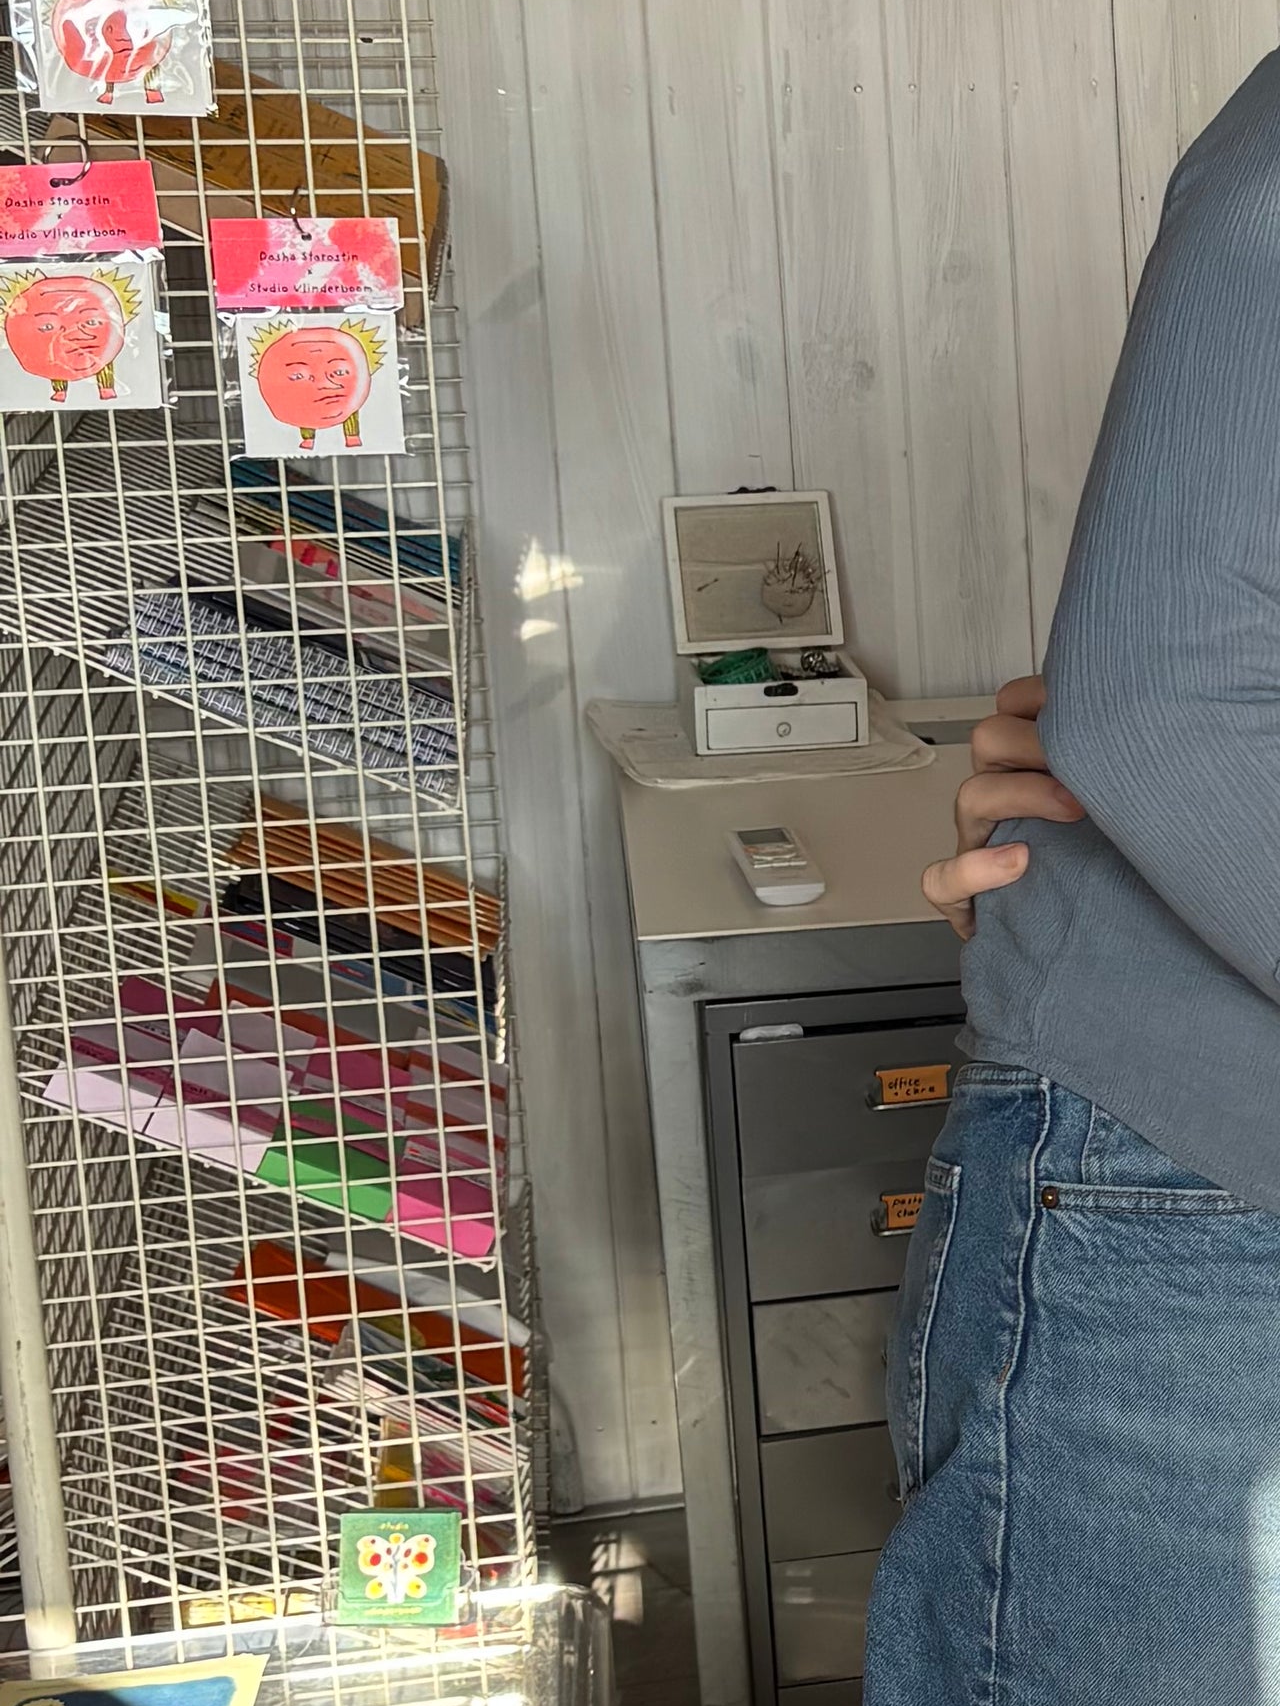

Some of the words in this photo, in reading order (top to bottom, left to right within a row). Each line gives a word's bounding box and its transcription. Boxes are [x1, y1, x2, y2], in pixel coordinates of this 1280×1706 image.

[4, 196, 44, 208] Dasha
[49, 195, 111, 207] Starostin
[43, 228, 127, 240] Vlinderboom
[259, 251, 297, 262] Dasha
[301, 251, 359, 262] Starostin
[249, 283, 289, 293] Studio
[293, 283, 373, 294] Vlinderboom
[887, 1077, 920, 1090] office
